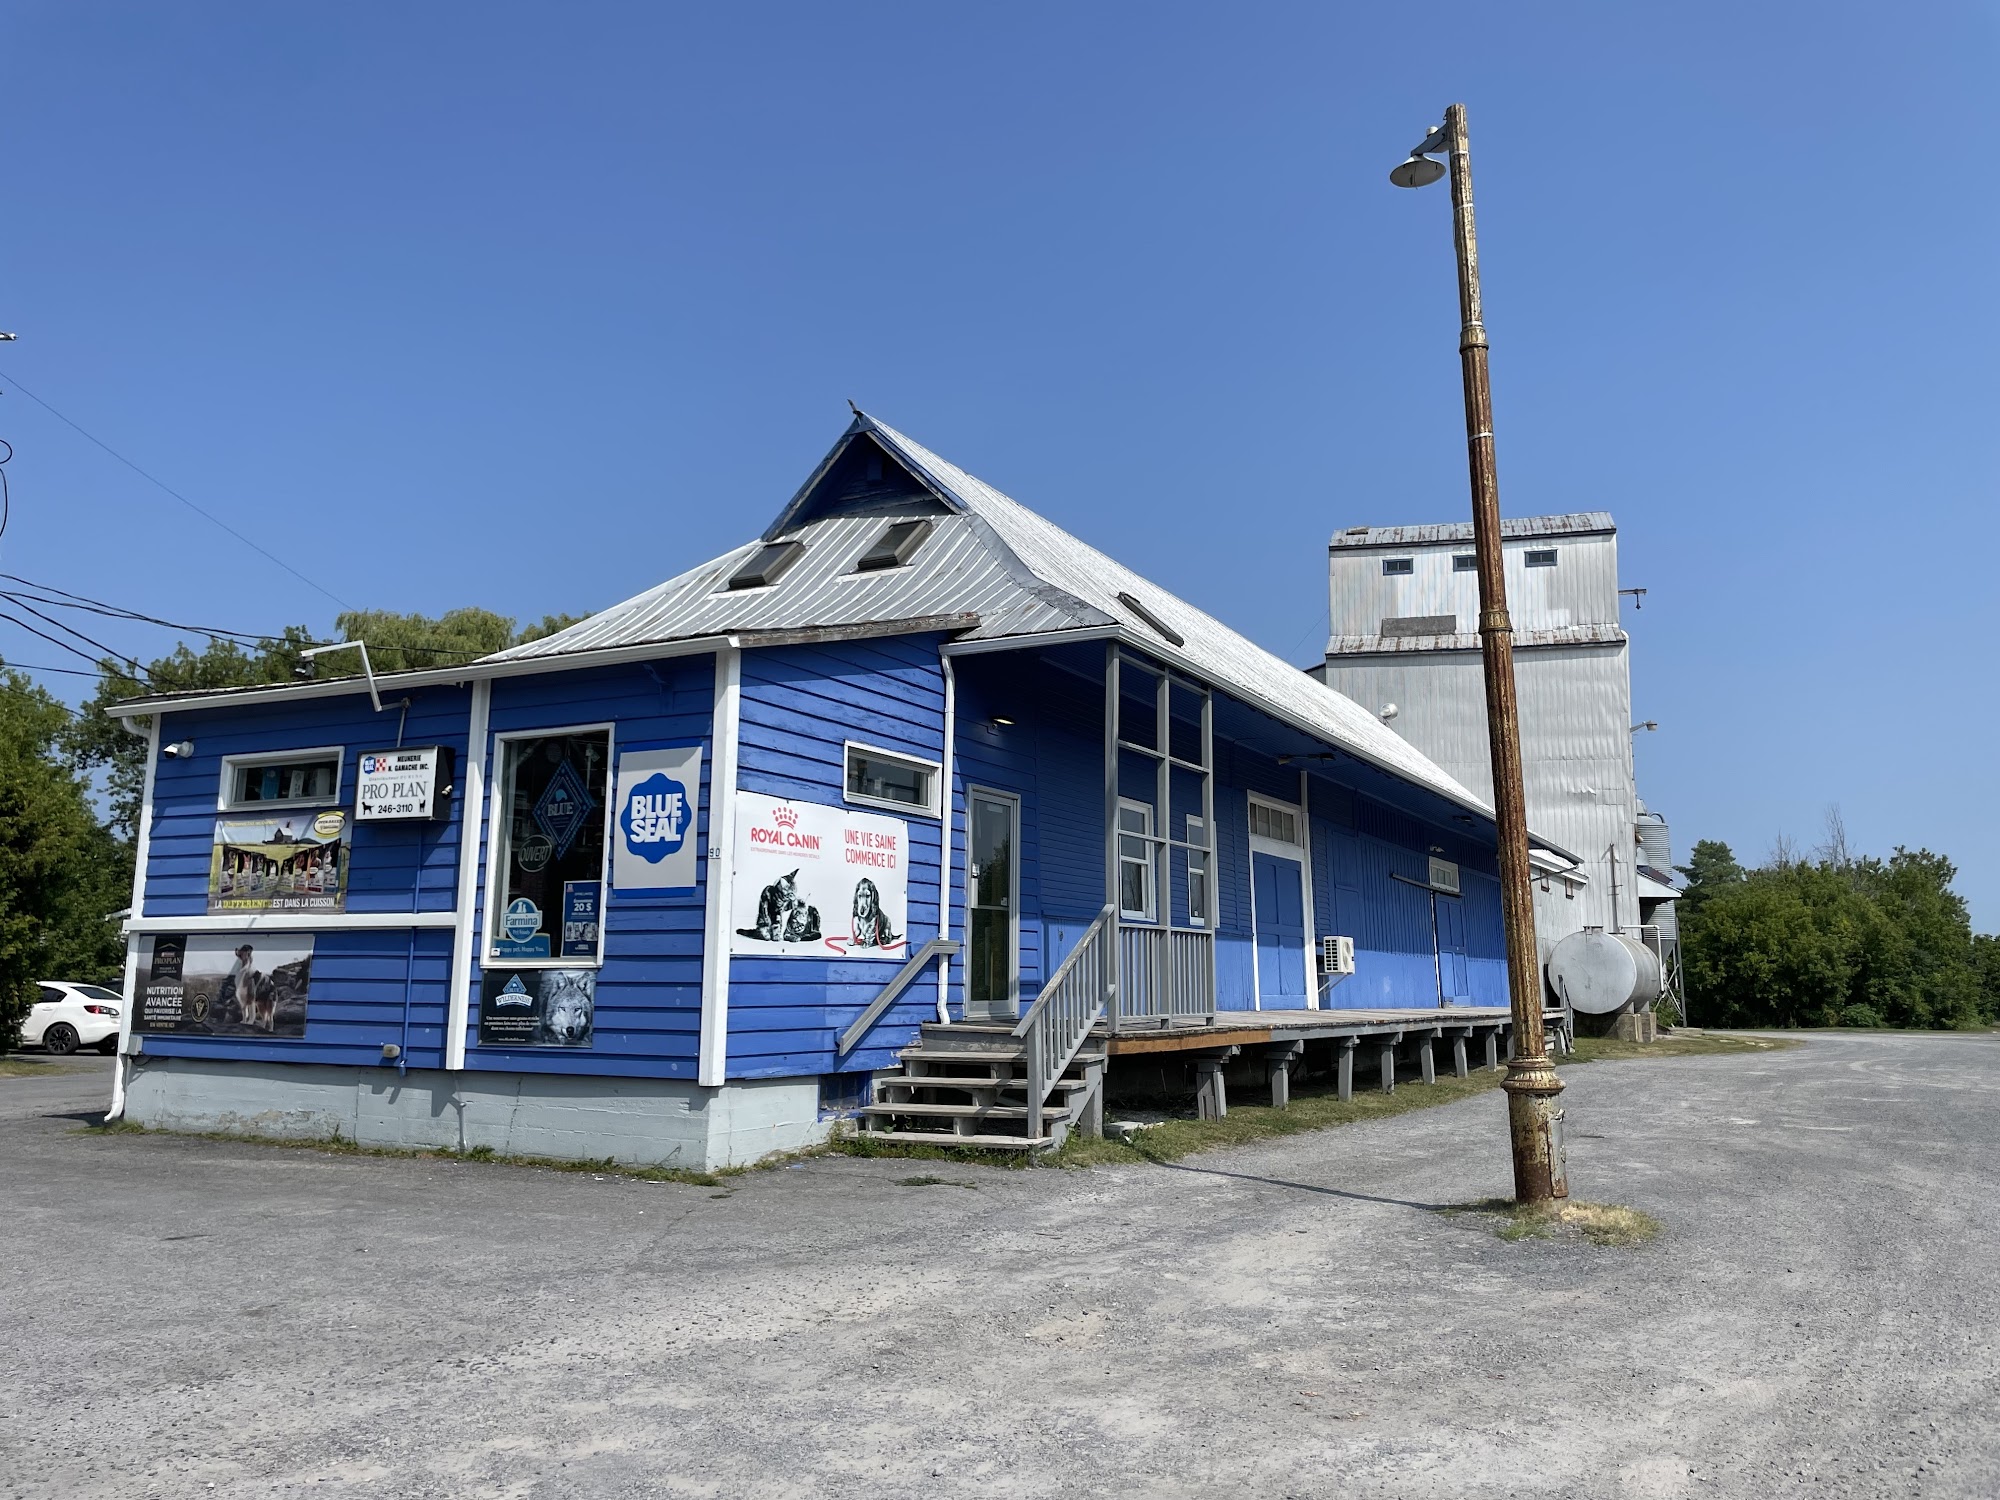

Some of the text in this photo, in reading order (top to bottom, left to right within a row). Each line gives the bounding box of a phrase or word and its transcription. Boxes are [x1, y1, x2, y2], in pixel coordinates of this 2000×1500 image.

[397, 755, 422, 763] MEUNERIE
[361, 781, 429, 799] PRO PLAN
[378, 803, 413, 814] 246-3110
[547, 802, 574, 816] BLUE
[631, 792, 682, 820] BLUE
[630, 817, 681, 843] SEAL
[751, 827, 820, 850] ROYAL CANIN
[844, 828, 897, 851] UNE VIE SAINE
[520, 845, 550, 862] OUVERT
[845, 848, 896, 869] COMMENCE ICI
[214, 900, 223, 909] LA
[272, 898, 284, 908] EST
[285, 898, 301, 908] DANS
[301, 897, 310, 908] LA
[573, 903, 592, 912] 20 $
[505, 914, 538, 926] Farmina
[146, 986, 184, 995] NUTRITION
[145, 995, 182, 1007] AVANCÉE
